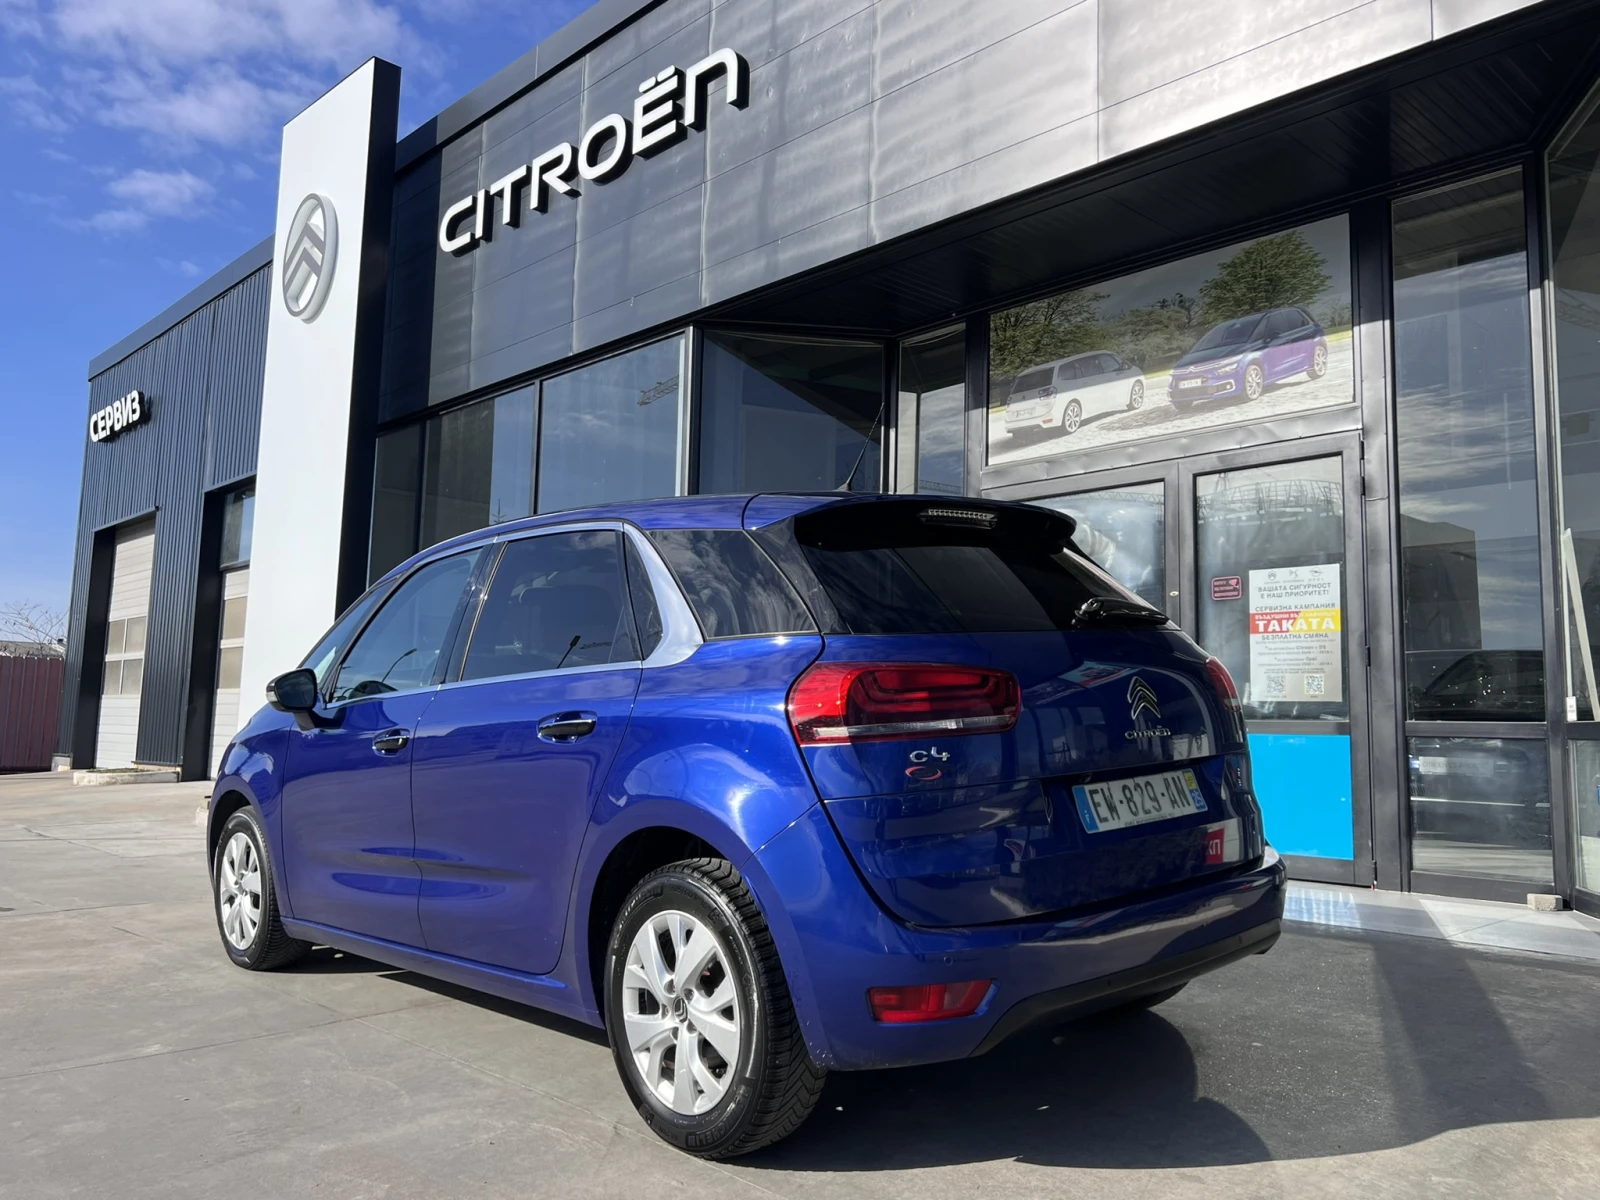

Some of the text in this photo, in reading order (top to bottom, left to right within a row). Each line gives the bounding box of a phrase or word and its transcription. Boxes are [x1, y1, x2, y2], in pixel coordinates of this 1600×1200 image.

[438, 47, 740, 253] CITROËN
[89, 389, 141, 443] СЕРВИЗ
[1258, 583, 1331, 593] ВАШАТА СИГУРНОСТ
[1266, 591, 1283, 599] НАШ
[1124, 725, 1171, 740] CITROËN
